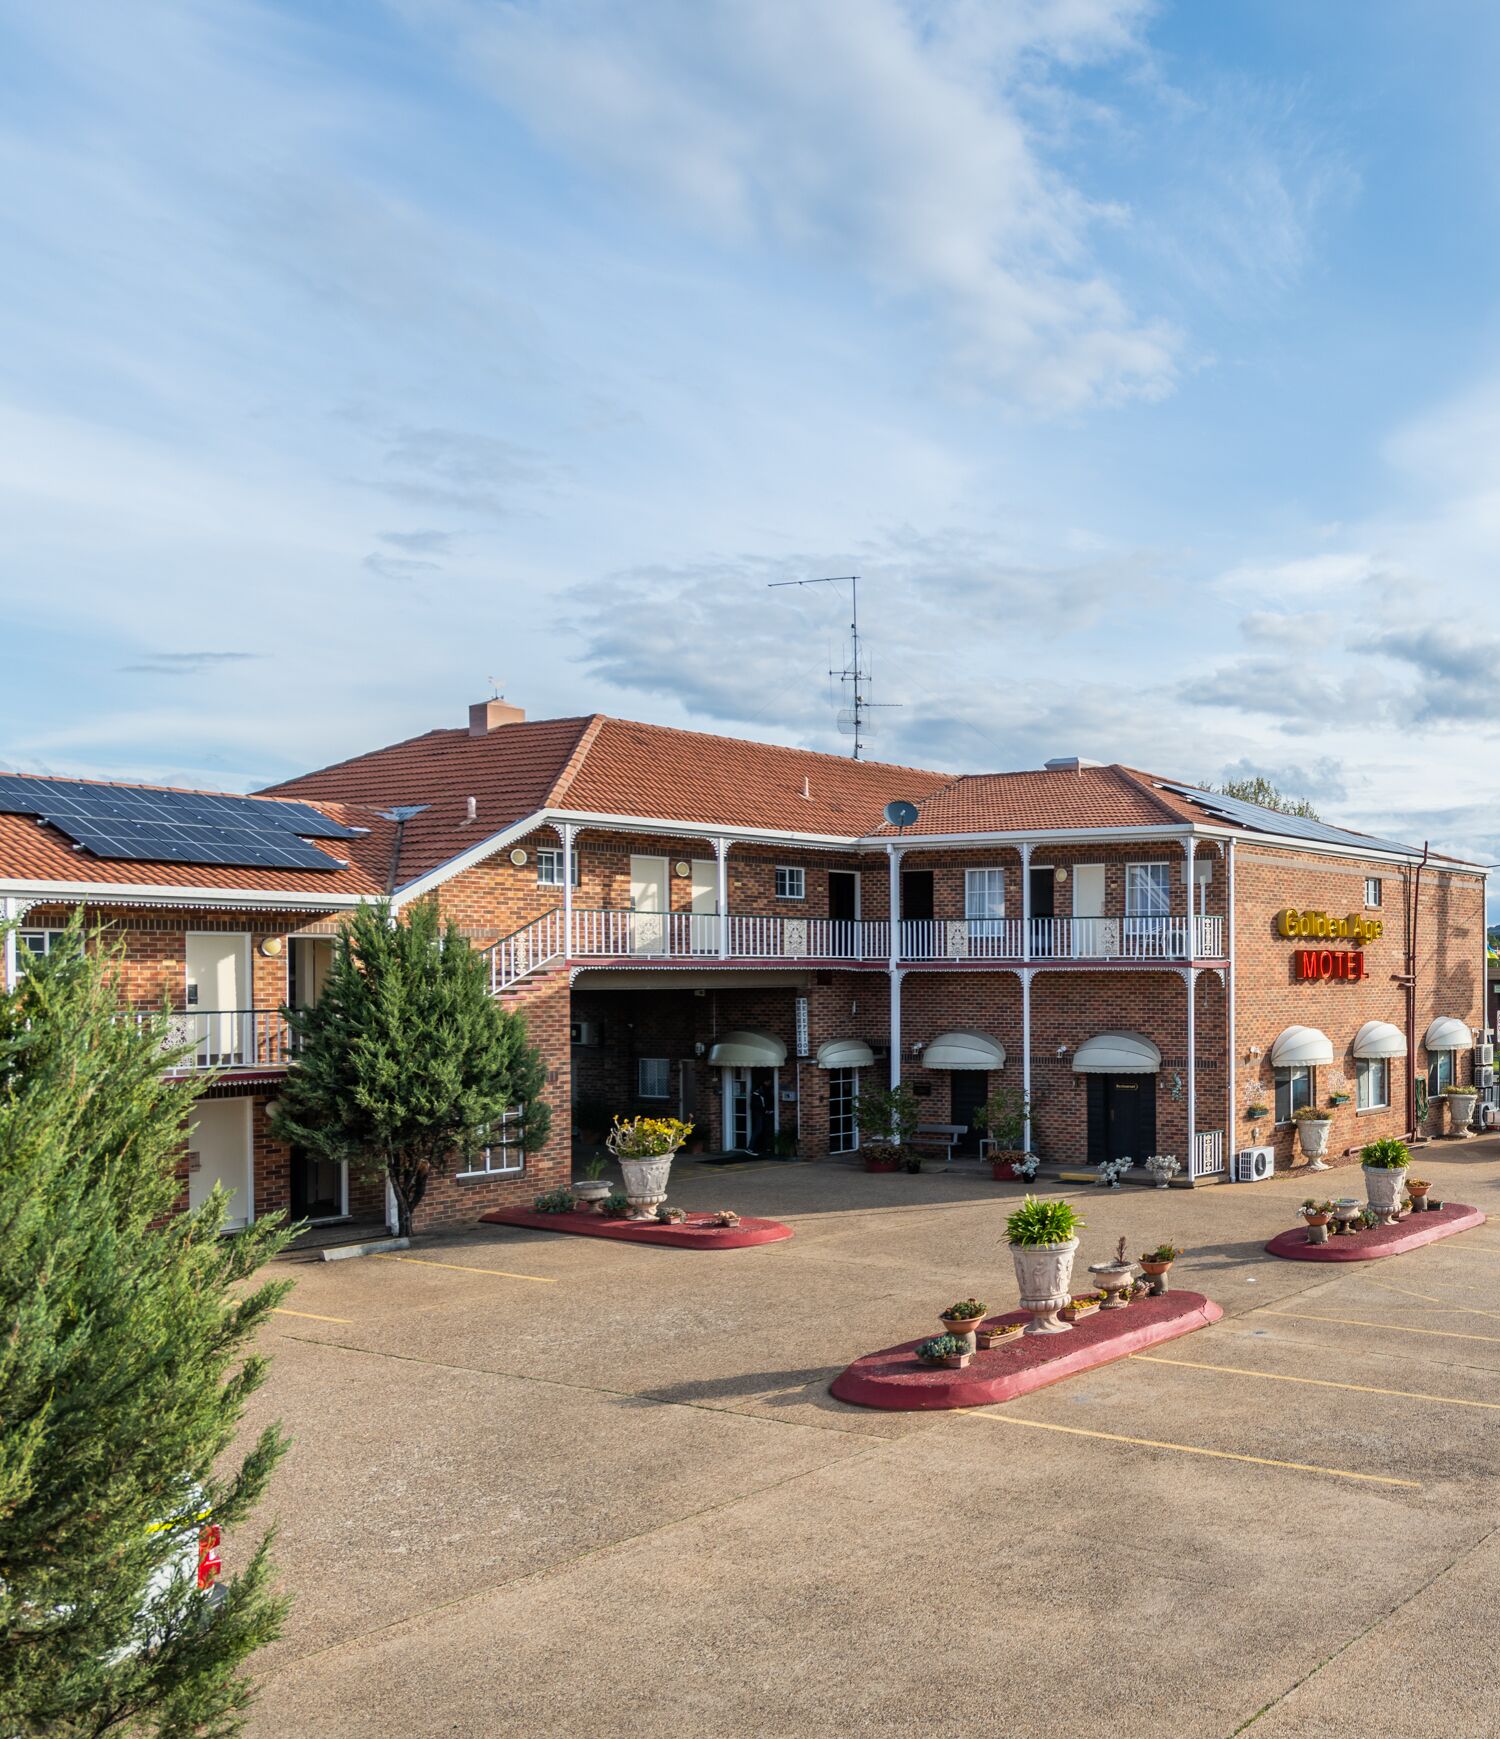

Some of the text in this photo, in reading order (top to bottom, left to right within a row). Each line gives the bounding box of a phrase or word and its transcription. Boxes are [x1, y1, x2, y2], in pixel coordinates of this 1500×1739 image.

[1285, 909, 1383, 945] Golden Age
[1303, 951, 1369, 980] MOTEL
